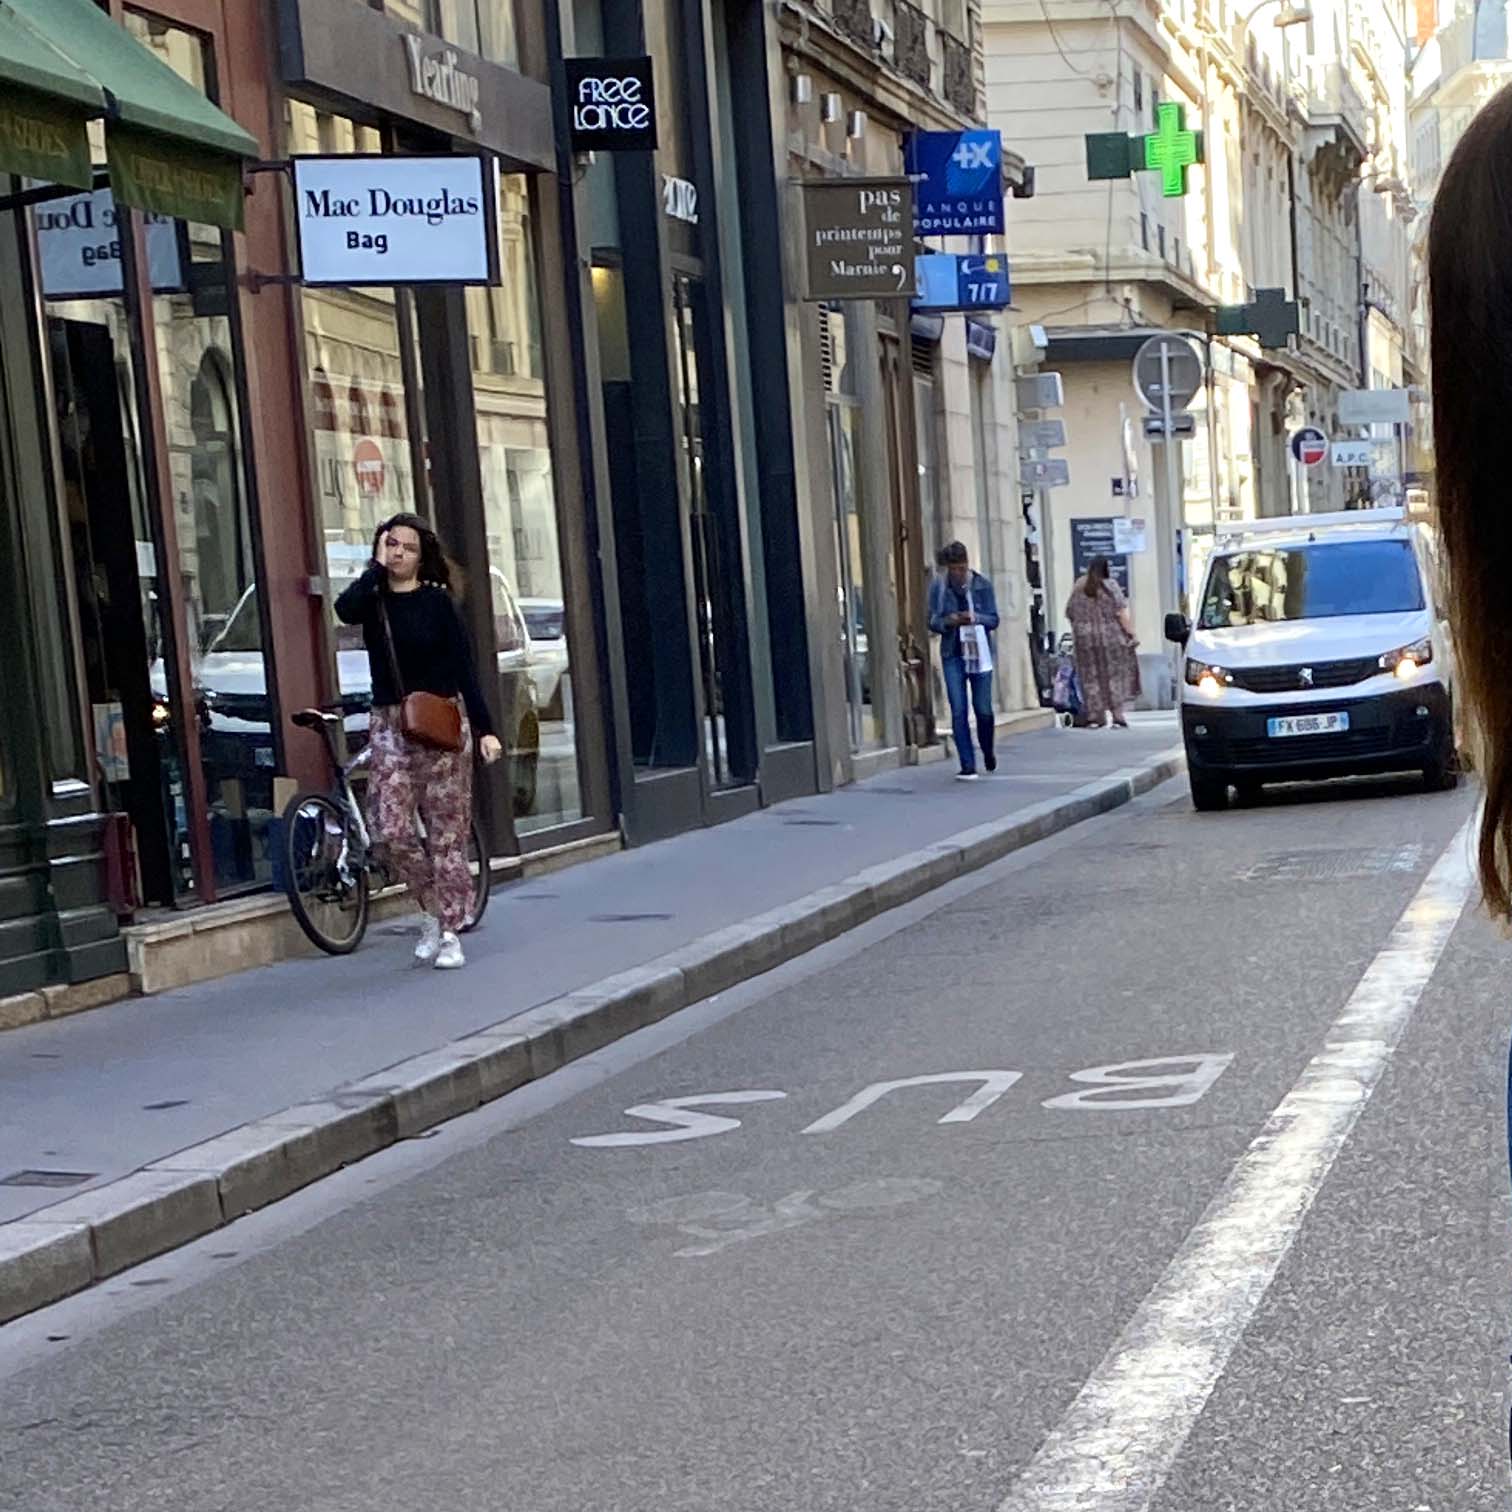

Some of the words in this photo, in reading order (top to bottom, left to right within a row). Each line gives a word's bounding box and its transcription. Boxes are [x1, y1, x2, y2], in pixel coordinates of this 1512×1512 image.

[304, 189, 361, 218] Mac
[367, 187, 479, 226] Douglas
[859, 189, 901, 214] pas
[881, 206, 901, 222] de
[346, 231, 389, 254] Bag
[815, 227, 903, 246] printemps
[830, 260, 889, 276] Marnie
[567, 1050, 1235, 1147] BUS
